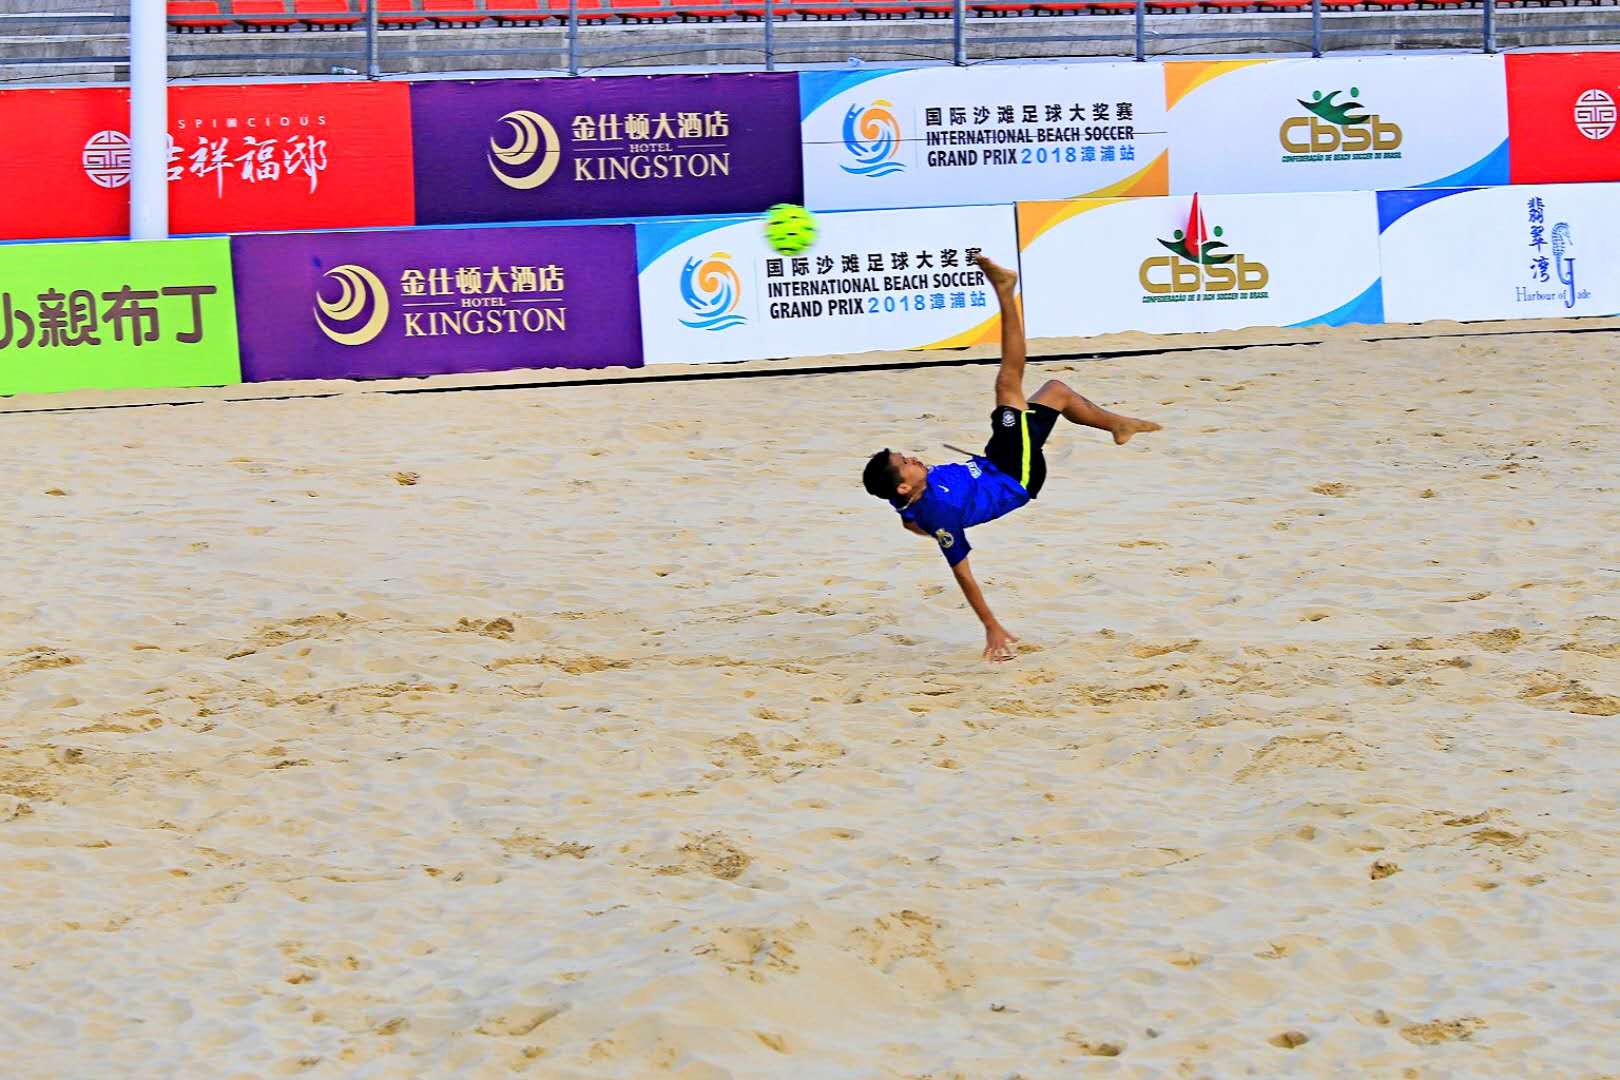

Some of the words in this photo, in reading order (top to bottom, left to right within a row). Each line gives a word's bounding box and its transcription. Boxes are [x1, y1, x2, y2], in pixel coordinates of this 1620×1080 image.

[925, 102, 1133, 126] 国际沙滩足球大奖赛
[571, 111, 729, 142] 金仕顿大酒店
[926, 129, 1033, 146] INTERNATIONAL
[1037, 127, 1080, 142] BEACH
[1084, 126, 1134, 141] SOCCER
[629, 143, 673, 153] HOTEL
[927, 150, 978, 167] GRAND
[983, 149, 1018, 165] PRIX
[573, 153, 731, 181] KINGSTON
[766, 247, 983, 278] 国际沙滩足球大奖赛
[400, 265, 565, 296] 金仕顿大酒店
[768, 276, 881, 298] INTERNATIONAL
[884, 273, 929, 291] BEACH
[933, 270, 985, 288] SOCCER
[461, 298, 506, 308] HOTEL
[1515, 286, 1556, 302] Harbour
[769, 300, 823, 319] GRAND
[828, 298, 865, 316] PRIX
[403, 307, 567, 337] KINGSTON
